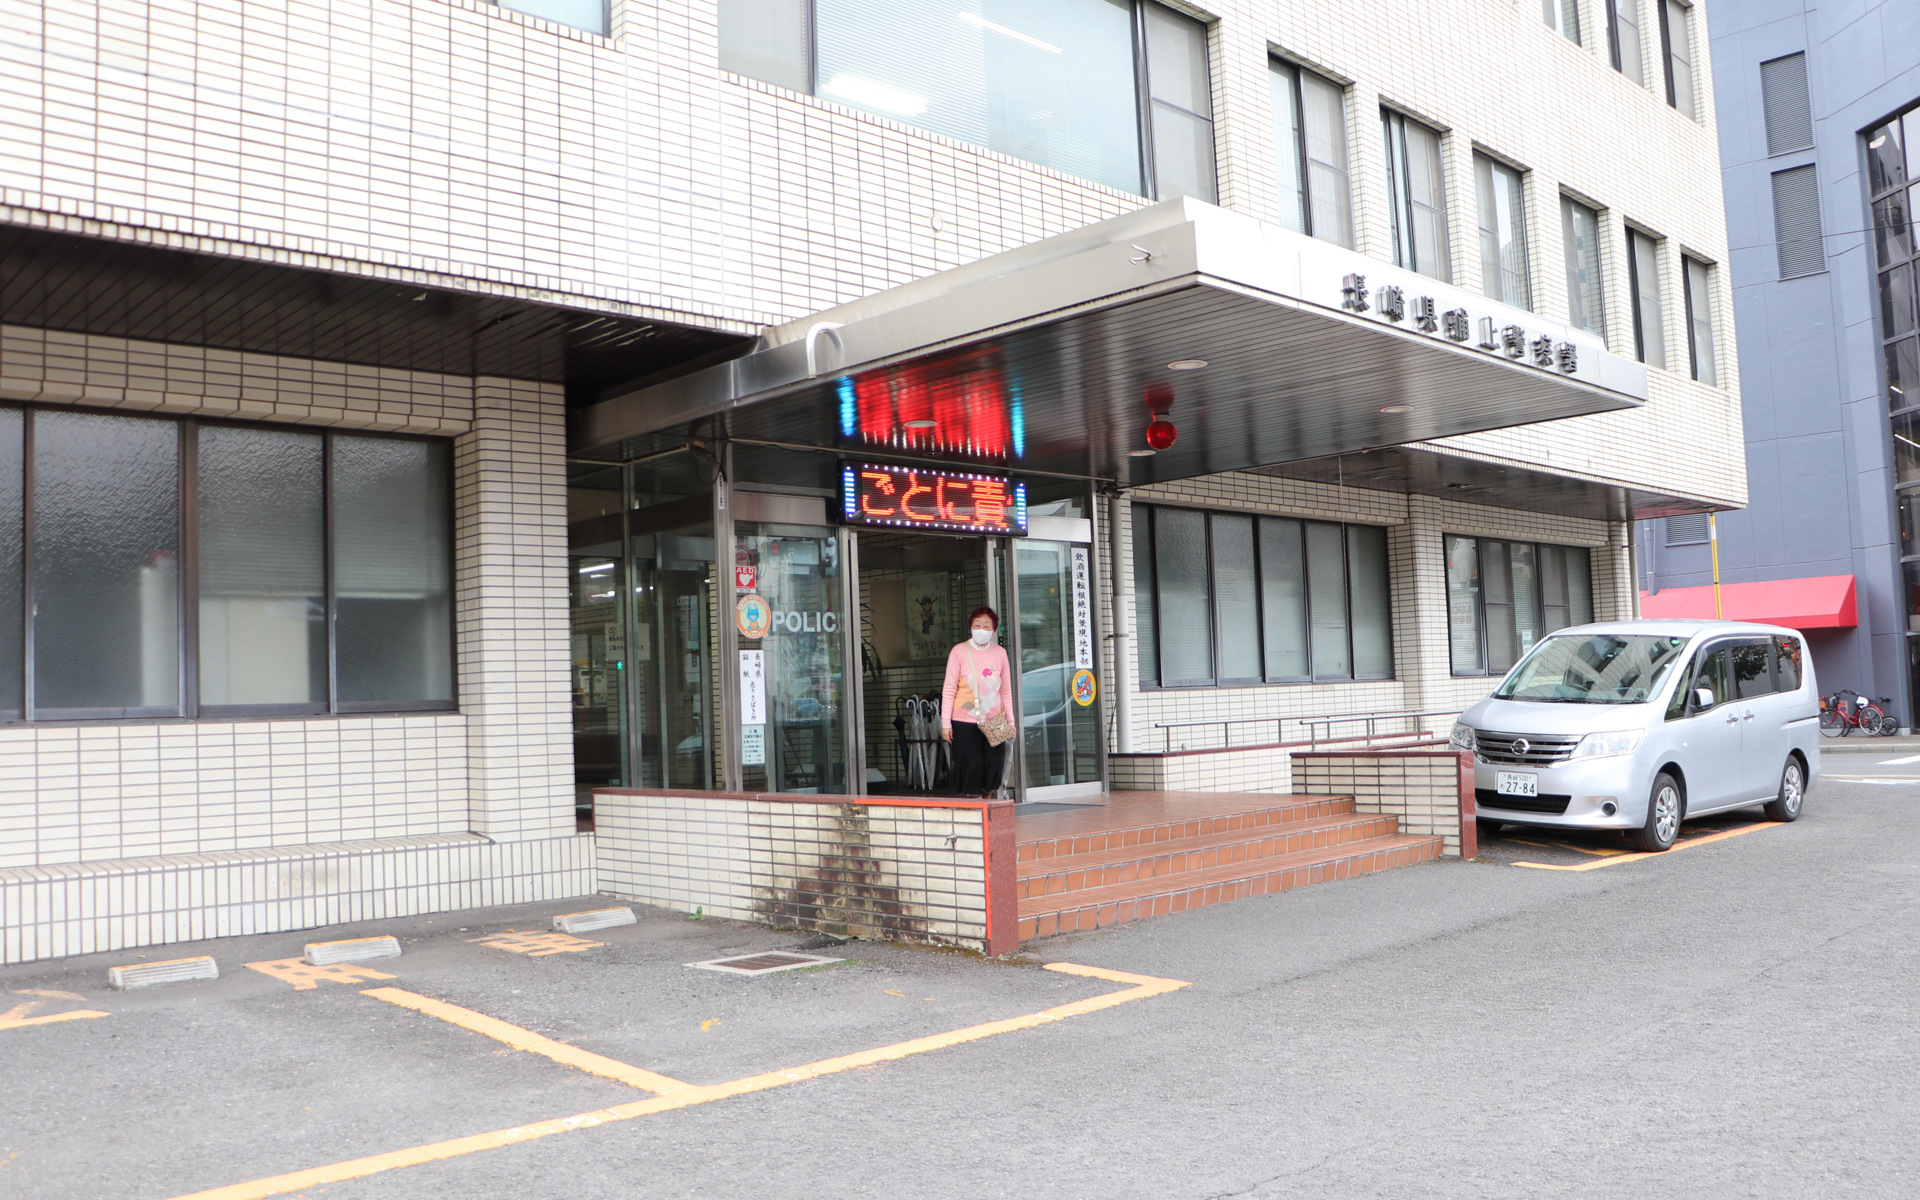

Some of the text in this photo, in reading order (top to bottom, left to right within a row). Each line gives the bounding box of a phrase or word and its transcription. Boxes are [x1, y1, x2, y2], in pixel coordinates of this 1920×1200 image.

[1341, 272, 1578, 373] 長崎県浦上警察署
[861, 471, 1014, 529] ごとに責
[772, 610, 842, 633] POLIC
[938, 595, 947, 632] 自転車
[1075, 552, 1089, 666] 飲酒運転根絶対策現地本部
[913, 639, 947, 652] つけてね
[742, 653, 750, 678] 証紙
[754, 652, 762, 678] 長崎県
[749, 680, 757, 722] 売りさばき所
[1506, 781, 1535, 794] 27-84
